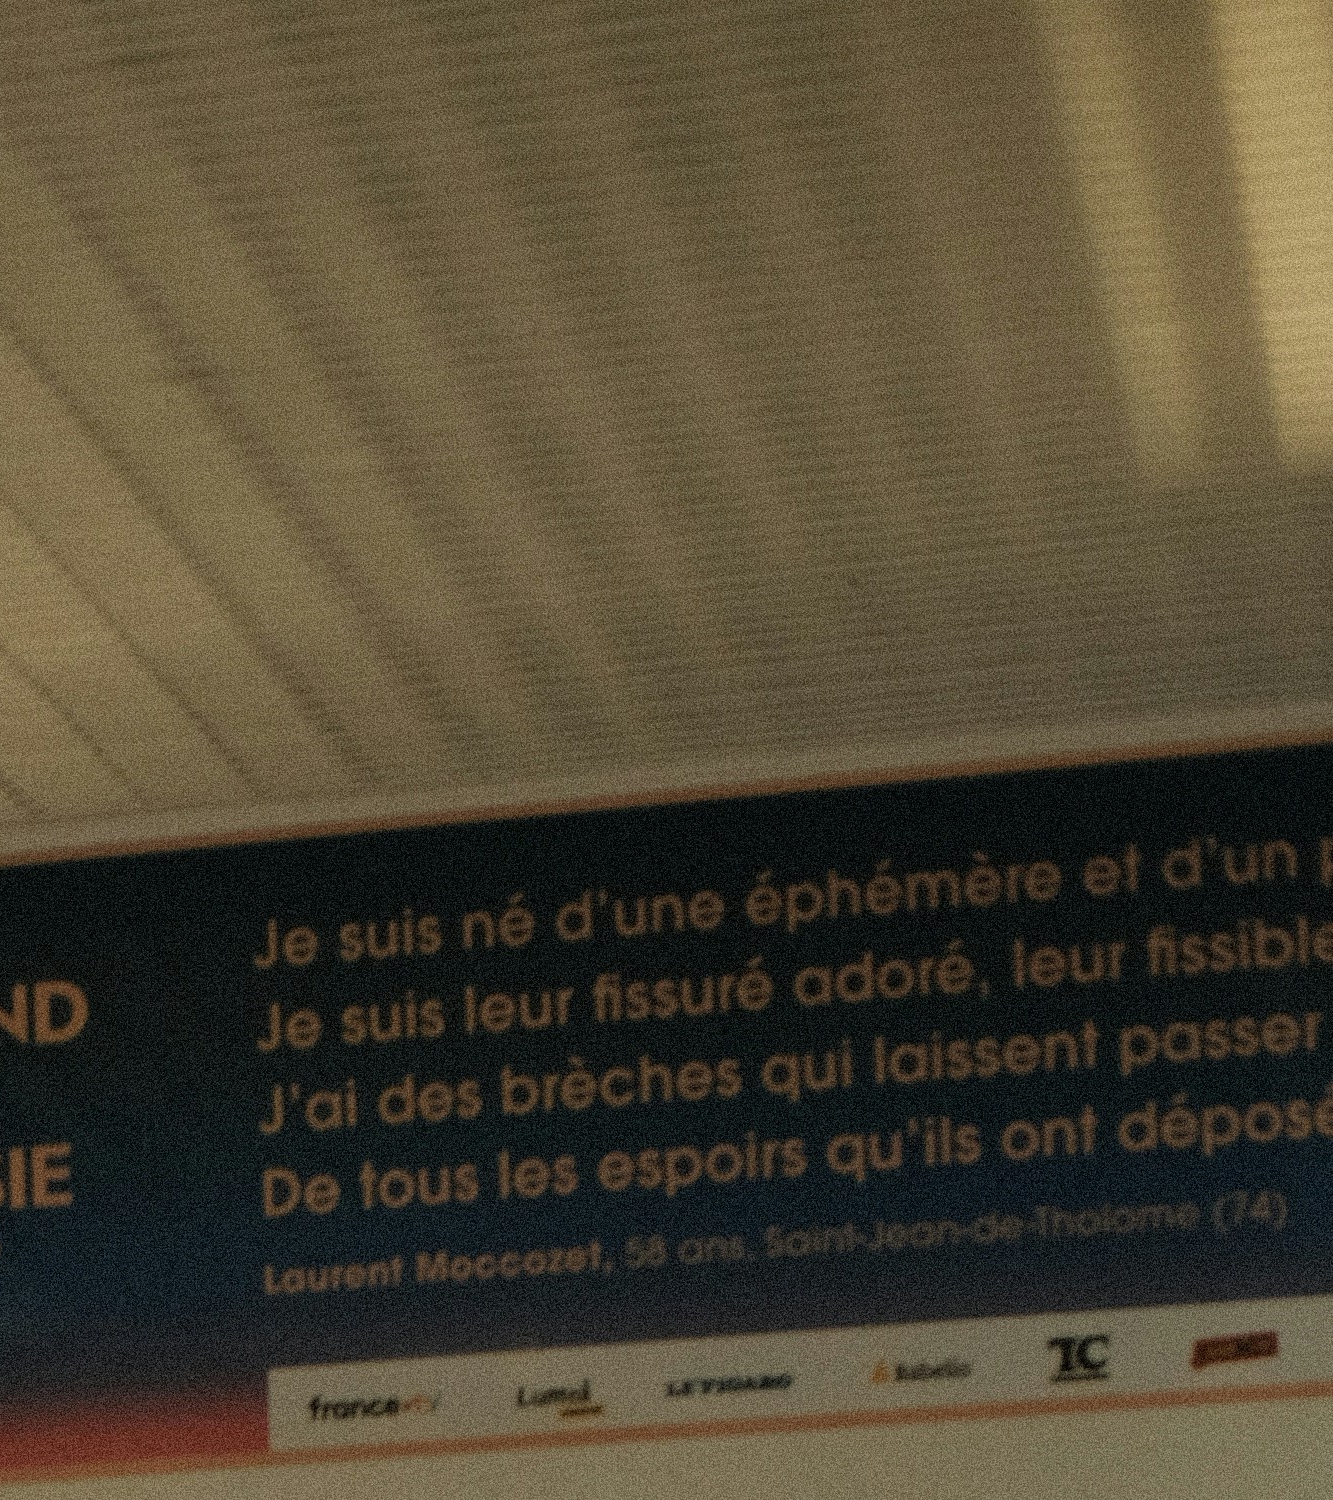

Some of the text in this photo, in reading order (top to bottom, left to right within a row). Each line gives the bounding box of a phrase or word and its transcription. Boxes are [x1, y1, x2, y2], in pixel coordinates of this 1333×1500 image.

[254, 919, 320, 969] Je
[339, 907, 443, 961] suis
[462, 890, 535, 948] né
[555, 887, 725, 942] d'une
[744, 852, 1061, 934] éphémère
[1083, 844, 1141, 896] et
[1162, 835, 1298, 889] d'un
[258, 1001, 323, 1052] Je
[341, 990, 446, 1045] suis
[464, 985, 573, 1034] leur
[593, 956, 774, 1023] fissuré
[794, 938, 991, 1002] adoré,
[1012, 939, 1126, 987] leur
[259, 1010, 1321, 1135] J'ai des brèches qui laissent passer
[262, 1166, 342, 1219] De
[359, 1159, 480, 1211] tous
[497, 1150, 579, 1200] les
[597, 1130, 808, 1198] espoirs
[825, 1117, 983, 1184] qu'ils
[1001, 1105, 1098, 1161] ont
[263, 1255, 404, 1296] Laurent
[415, 1241, 615, 1284] Moccozet,
[623, 1236, 667, 1268] 58
[1211, 1189, 1290, 1236] (74)
